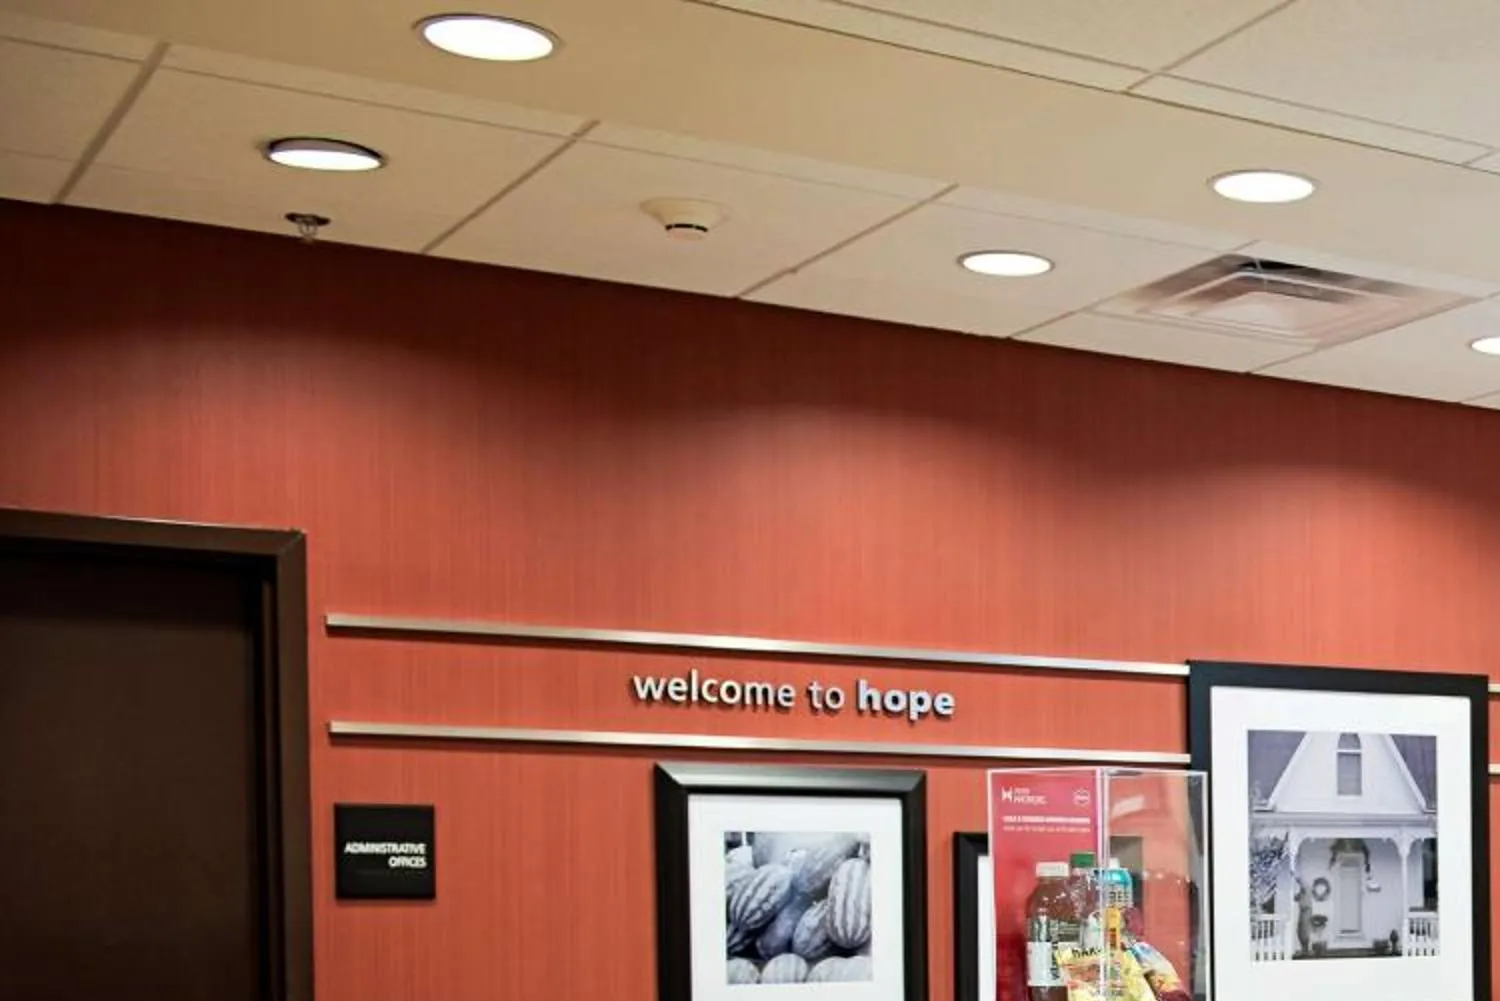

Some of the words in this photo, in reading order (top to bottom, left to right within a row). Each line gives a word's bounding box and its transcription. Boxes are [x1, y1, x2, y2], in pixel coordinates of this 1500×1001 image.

[633, 669, 796, 708] welcome
[808, 681, 845, 710] to
[856, 680, 956, 720] hope
[344, 841, 427, 855] ADMINISTRATIVE
[388, 855, 427, 868] OFFICES
